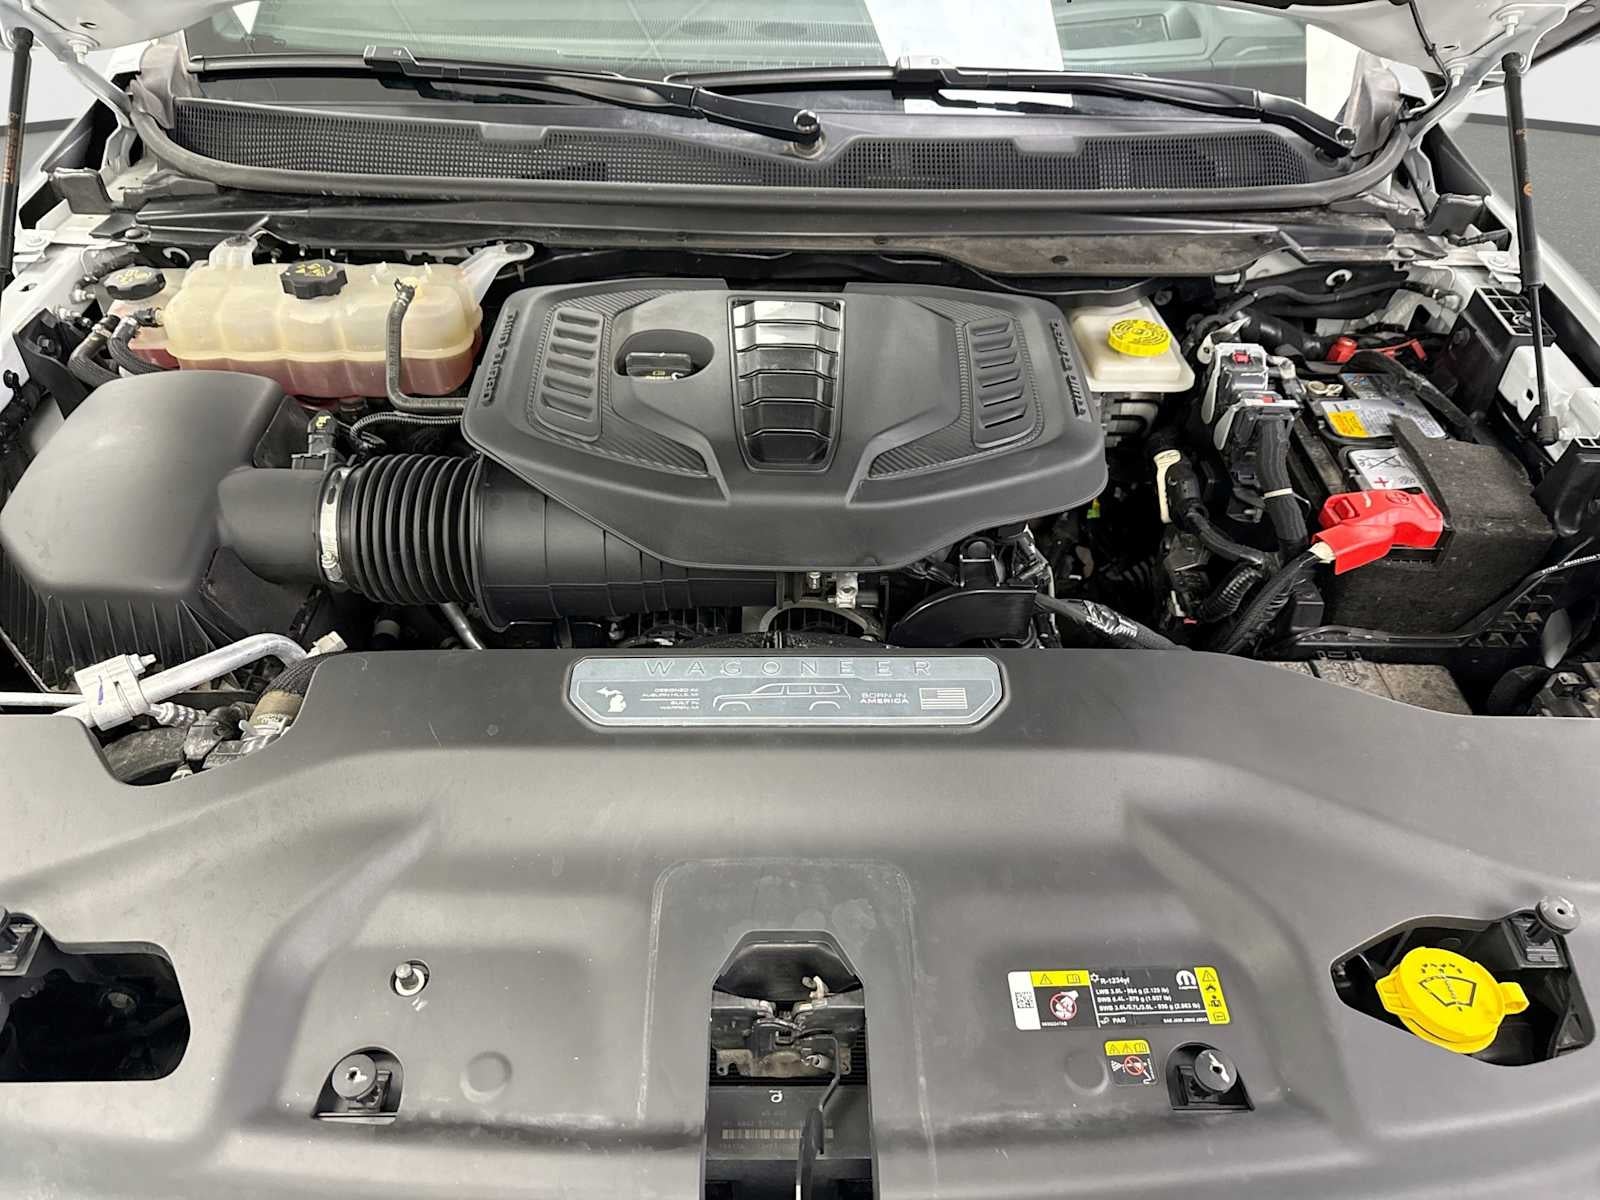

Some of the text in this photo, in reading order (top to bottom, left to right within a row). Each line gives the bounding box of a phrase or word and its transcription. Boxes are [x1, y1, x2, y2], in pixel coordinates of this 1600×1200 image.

[644, 660, 931, 676] WAGONEER
[1100, 976, 1130, 985] R-1234yf
[1112, 1016, 1126, 1024] PAG
